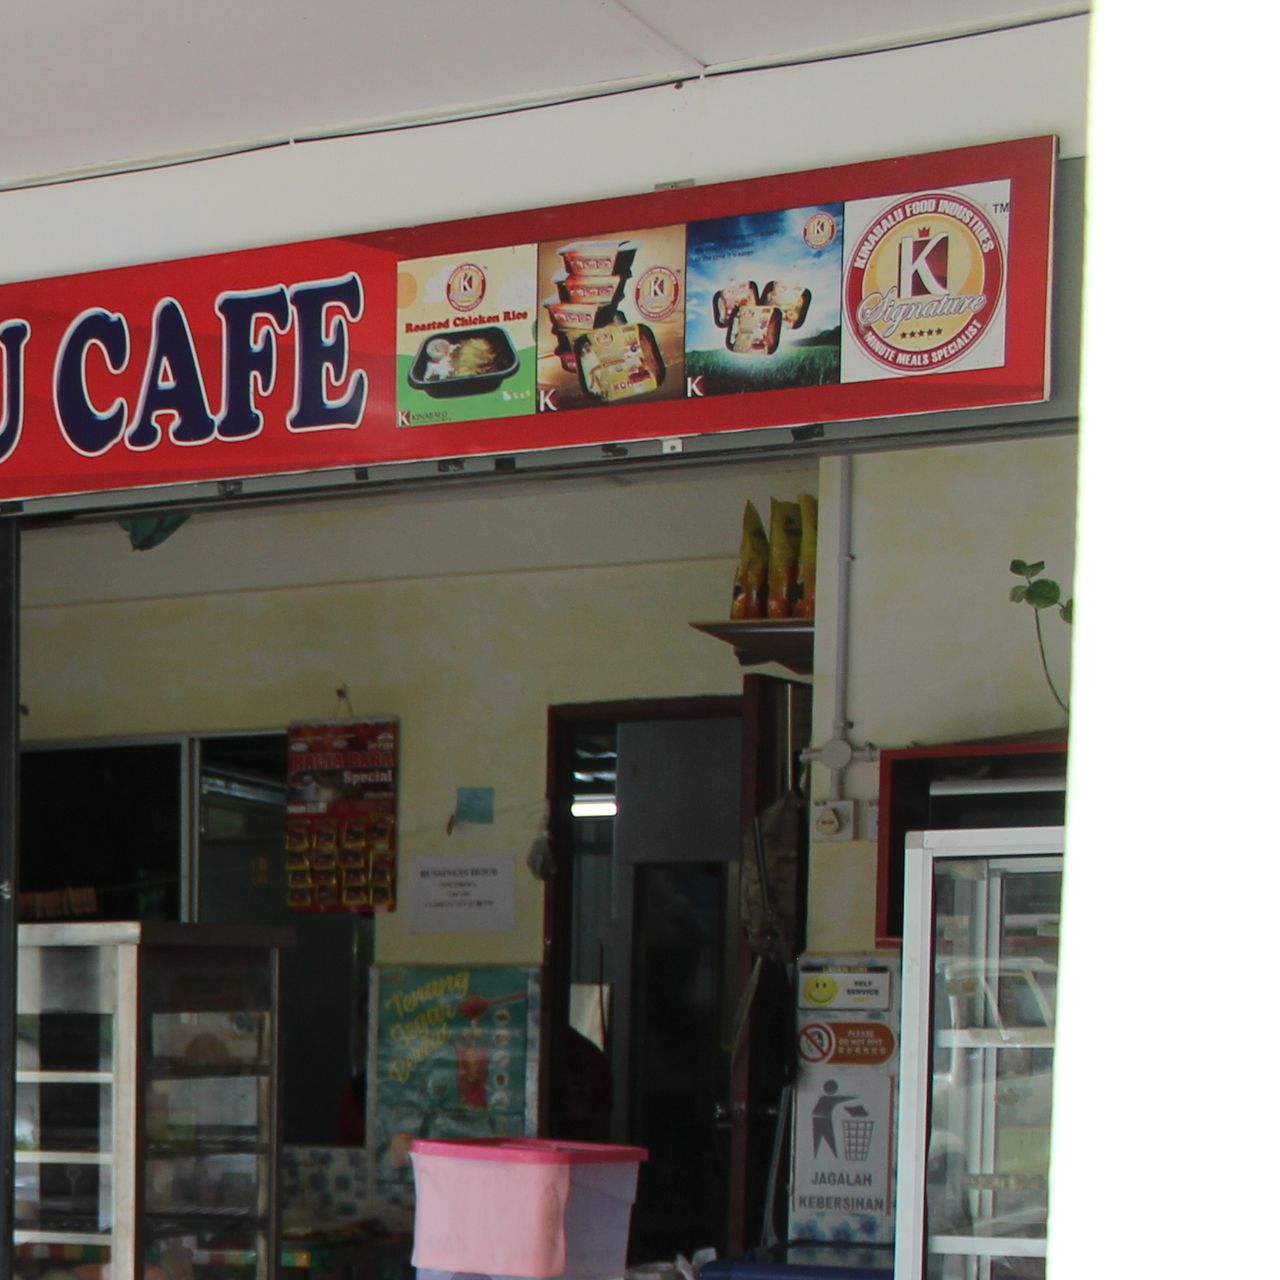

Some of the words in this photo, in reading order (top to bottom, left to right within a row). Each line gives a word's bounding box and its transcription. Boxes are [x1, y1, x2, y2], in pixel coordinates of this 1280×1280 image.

[853, 207, 908, 269] KINABALU
[905, 199, 937, 218] FOOD
[938, 199, 995, 254] INDUSTRIES
[405, 318, 450, 334] Roasted
[453, 313, 500, 328] Chicken
[503, 310, 528, 323] Rice
[857, 286, 987, 339] Signature
[863, 331, 894, 362] MINUTE
[896, 352, 930, 367] MEALS
[931, 319, 983, 364] SPECIALIST
[54, 271, 369, 457] CAFE
[686, 375, 704, 398] K
[540, 388, 558, 412] K
[343, 769, 393, 787] Special
[846, 988, 880, 996] SERVICE
[811, 1172, 873, 1187] JAGALAH
[798, 1196, 884, 1211] KEBERSIHAN
